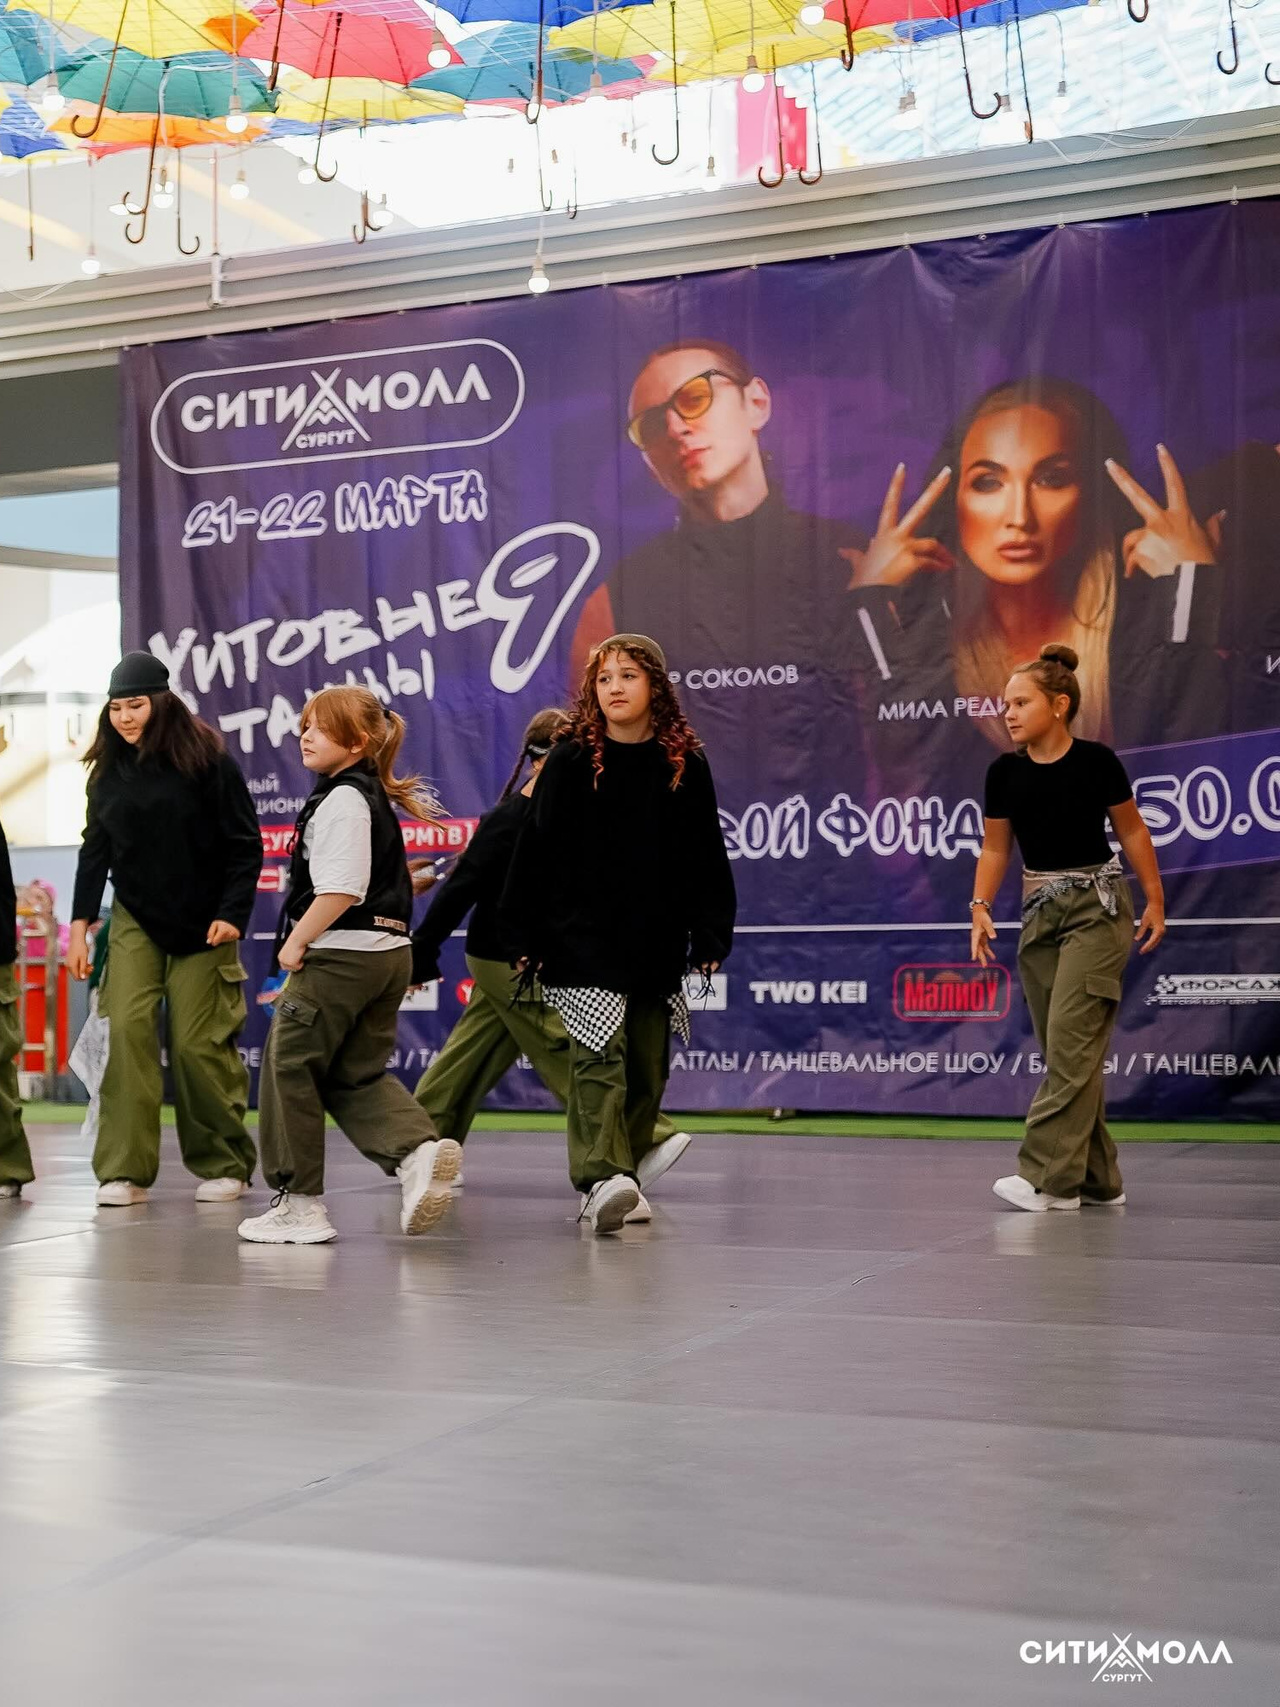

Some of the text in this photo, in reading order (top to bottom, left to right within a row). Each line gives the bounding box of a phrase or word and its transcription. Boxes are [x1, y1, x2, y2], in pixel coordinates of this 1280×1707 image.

[181, 363, 491, 432] СИТИ МОЛЛ
[295, 428, 356, 449] СУРГУТ
[182, 469, 488, 548] 21-22 МАРТА
[685, 664, 799, 690] СОКОЛОВ
[878, 699, 948, 721] МИЛА
[749, 981, 868, 1004] TWO KEI
[761, 1051, 939, 1074] ТАНЦЕВАЛЬНОЕ
[944, 1051, 1005, 1074] ШОУ
[1143, 1053, 1280, 1077] ТАНЦЕВАЛ
